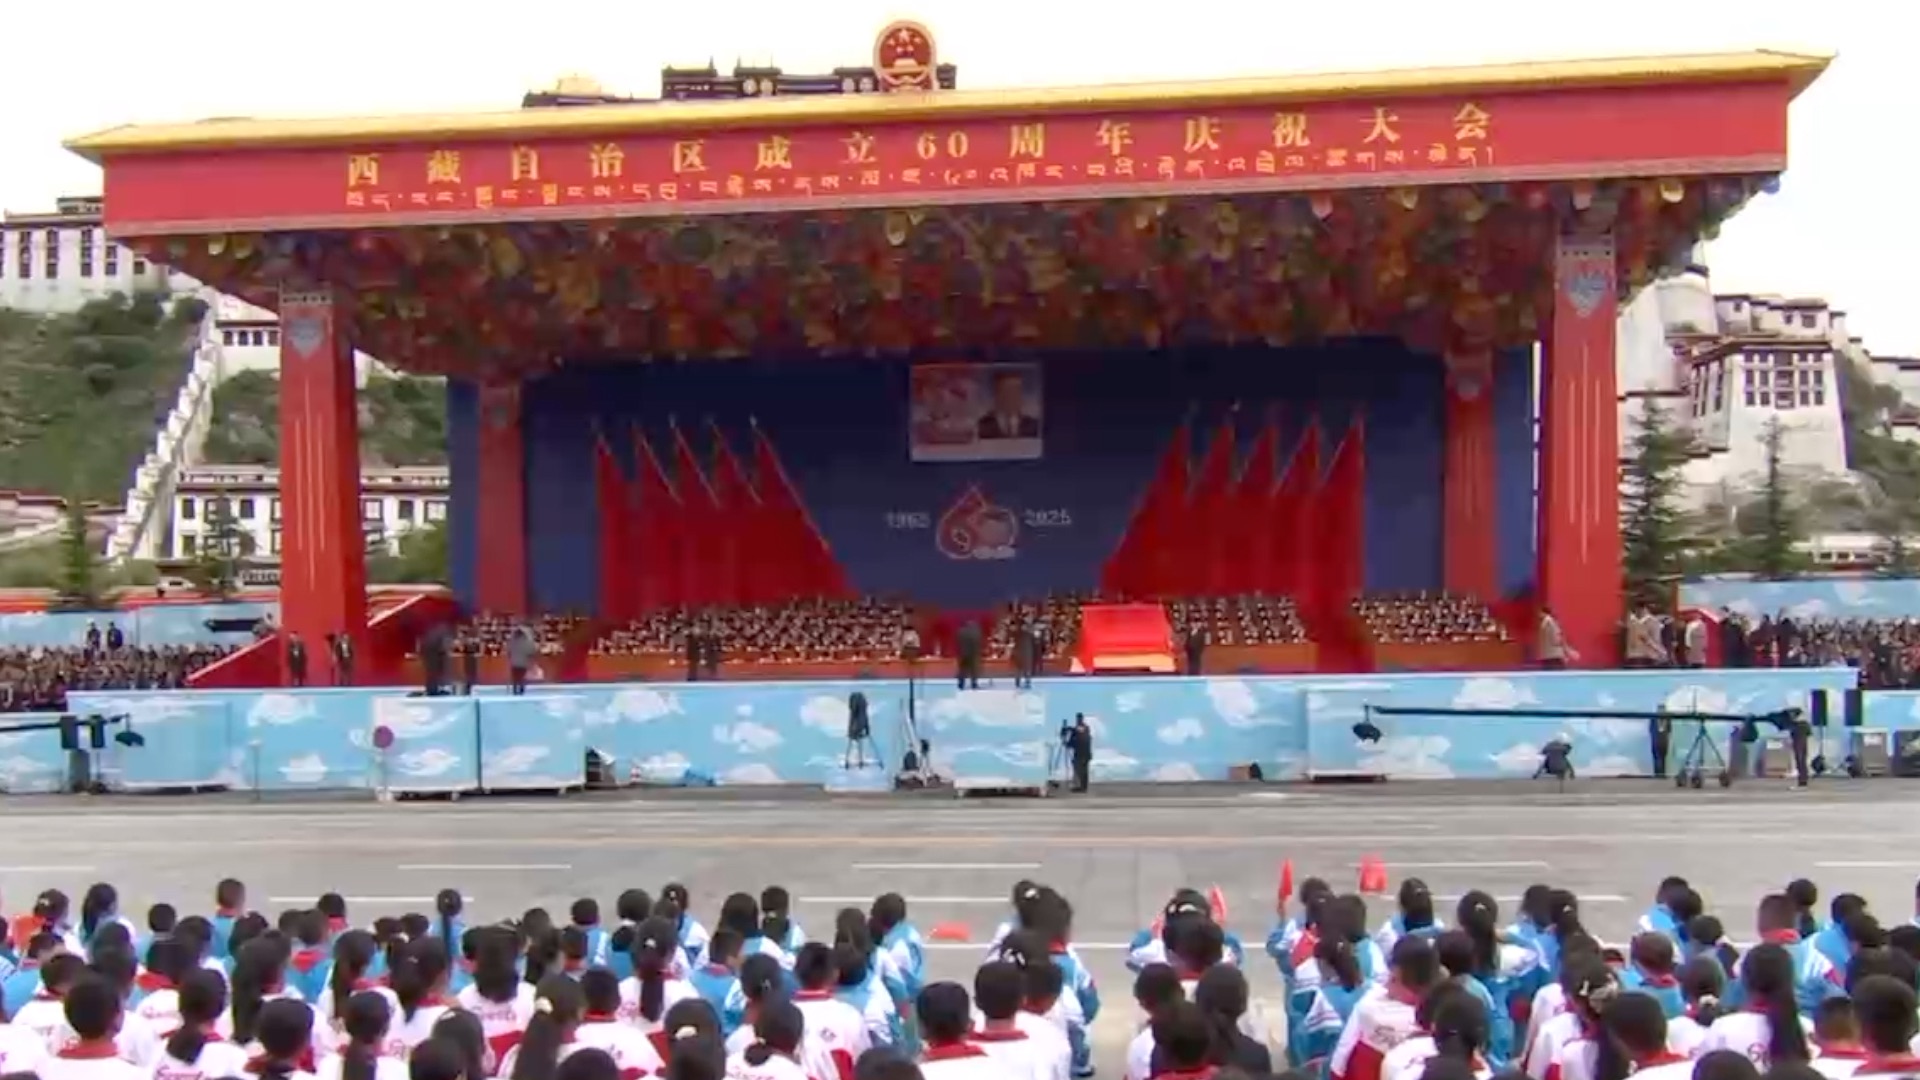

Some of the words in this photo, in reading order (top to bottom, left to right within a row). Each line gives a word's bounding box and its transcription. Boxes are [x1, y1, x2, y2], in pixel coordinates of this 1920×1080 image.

[347, 103, 1491, 186] 西藏自治区成立60周年庆祝大会
[1024, 508, 1072, 527] 2025
